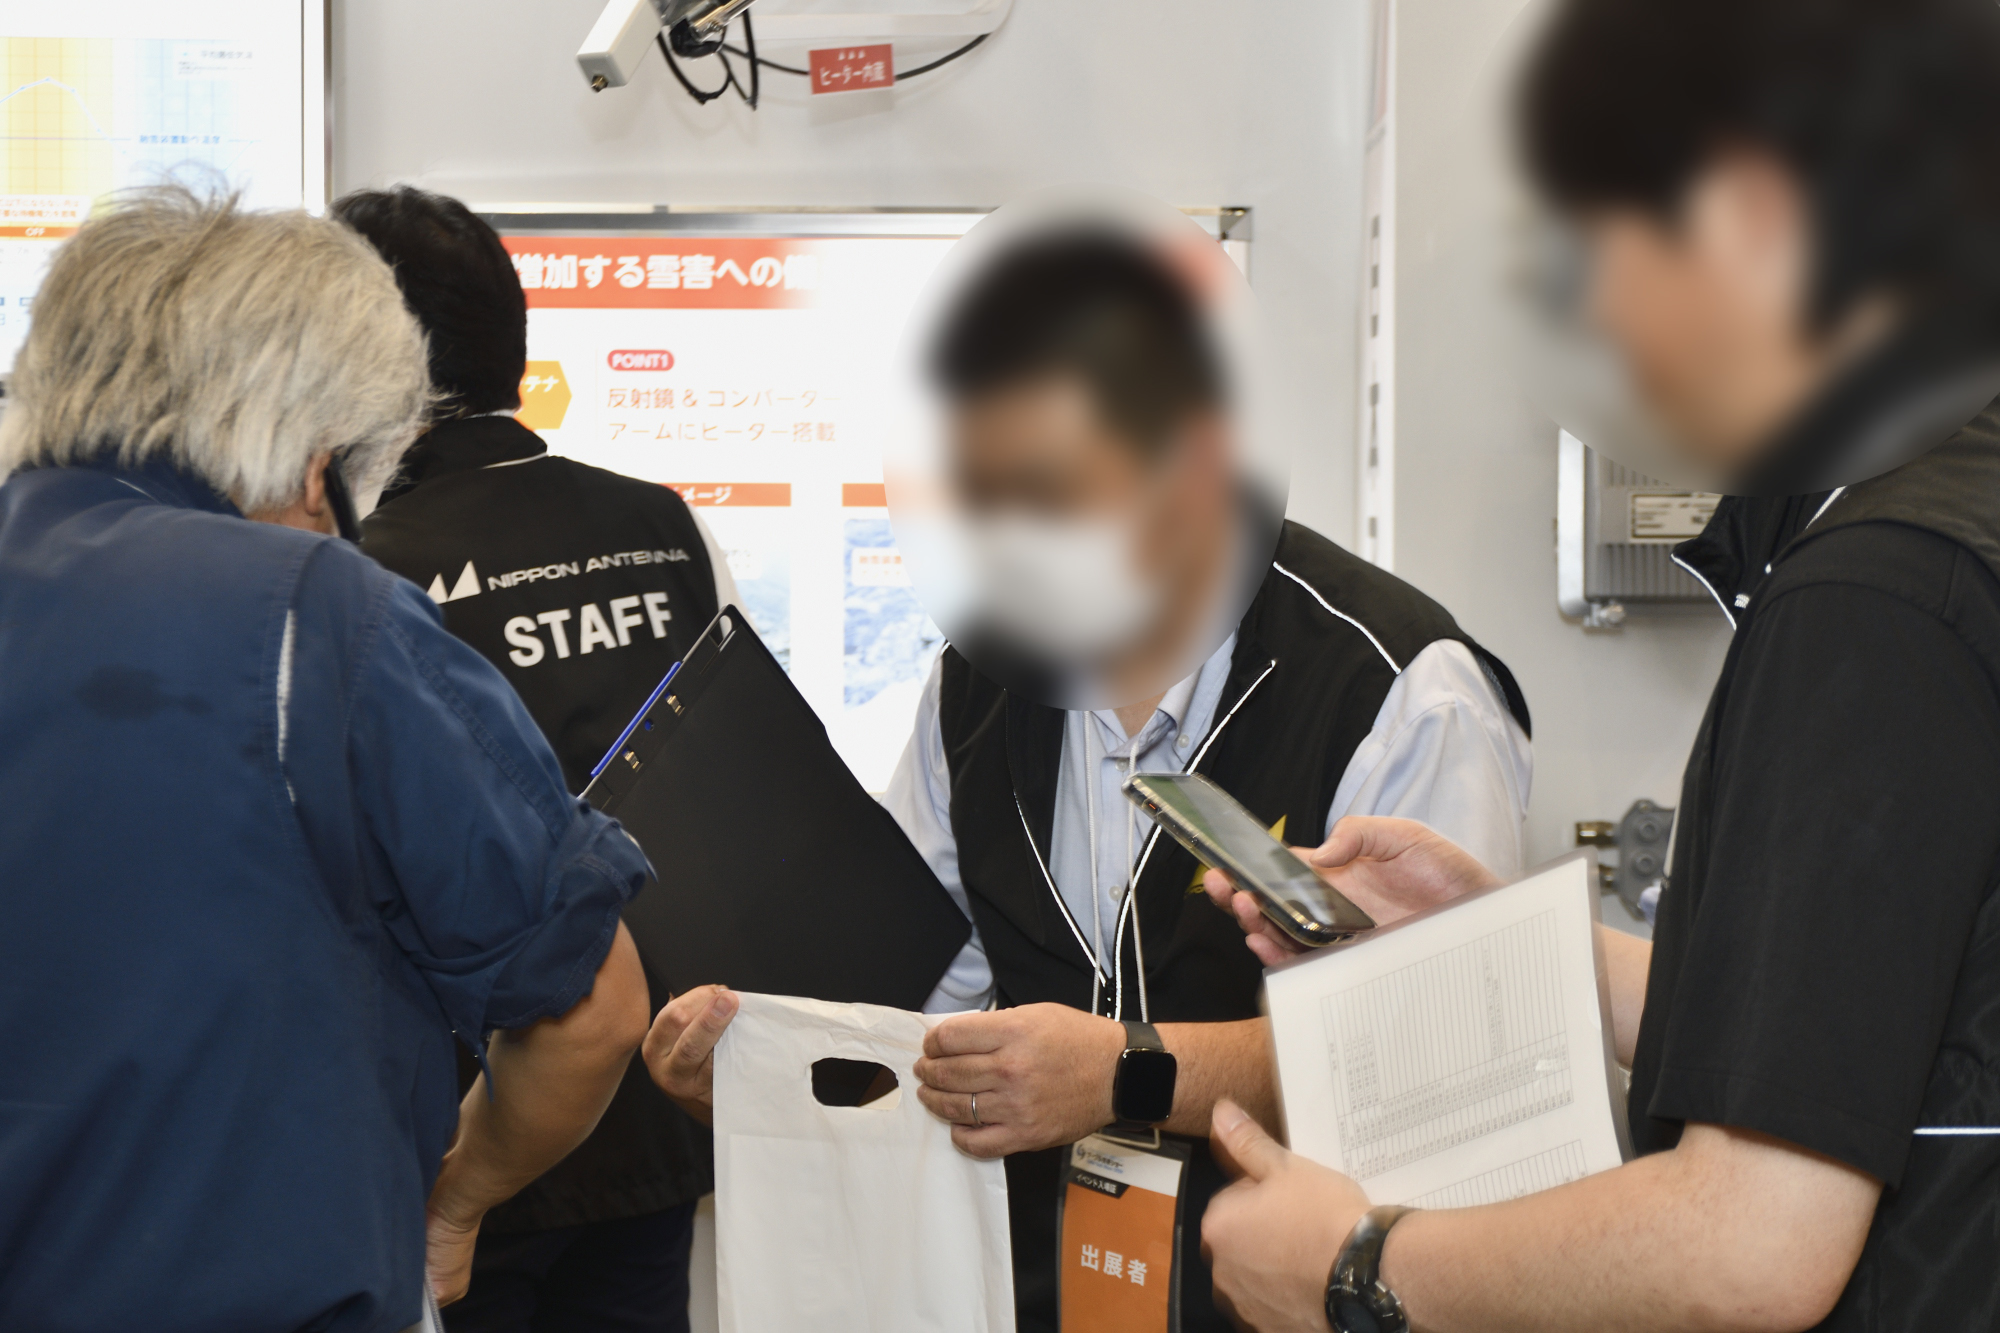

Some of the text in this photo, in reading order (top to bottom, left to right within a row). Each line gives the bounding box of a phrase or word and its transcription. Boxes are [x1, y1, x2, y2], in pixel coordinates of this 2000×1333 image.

[819, 61, 885, 86] ヒーター内蔵
[25, 226, 45, 237] OFF
[612, 353, 669, 368] POINT1
[520, 375, 560, 393] テナ
[607, 387, 840, 409] 反射鏡 & コンバーター
[608, 421, 836, 443] アームにヒーター搭載
[487, 561, 580, 591] NIPPON
[585, 548, 691, 573] ANTENNA
[503, 591, 672, 667] STAFF
[1081, 1244, 1148, 1287] 出展者
